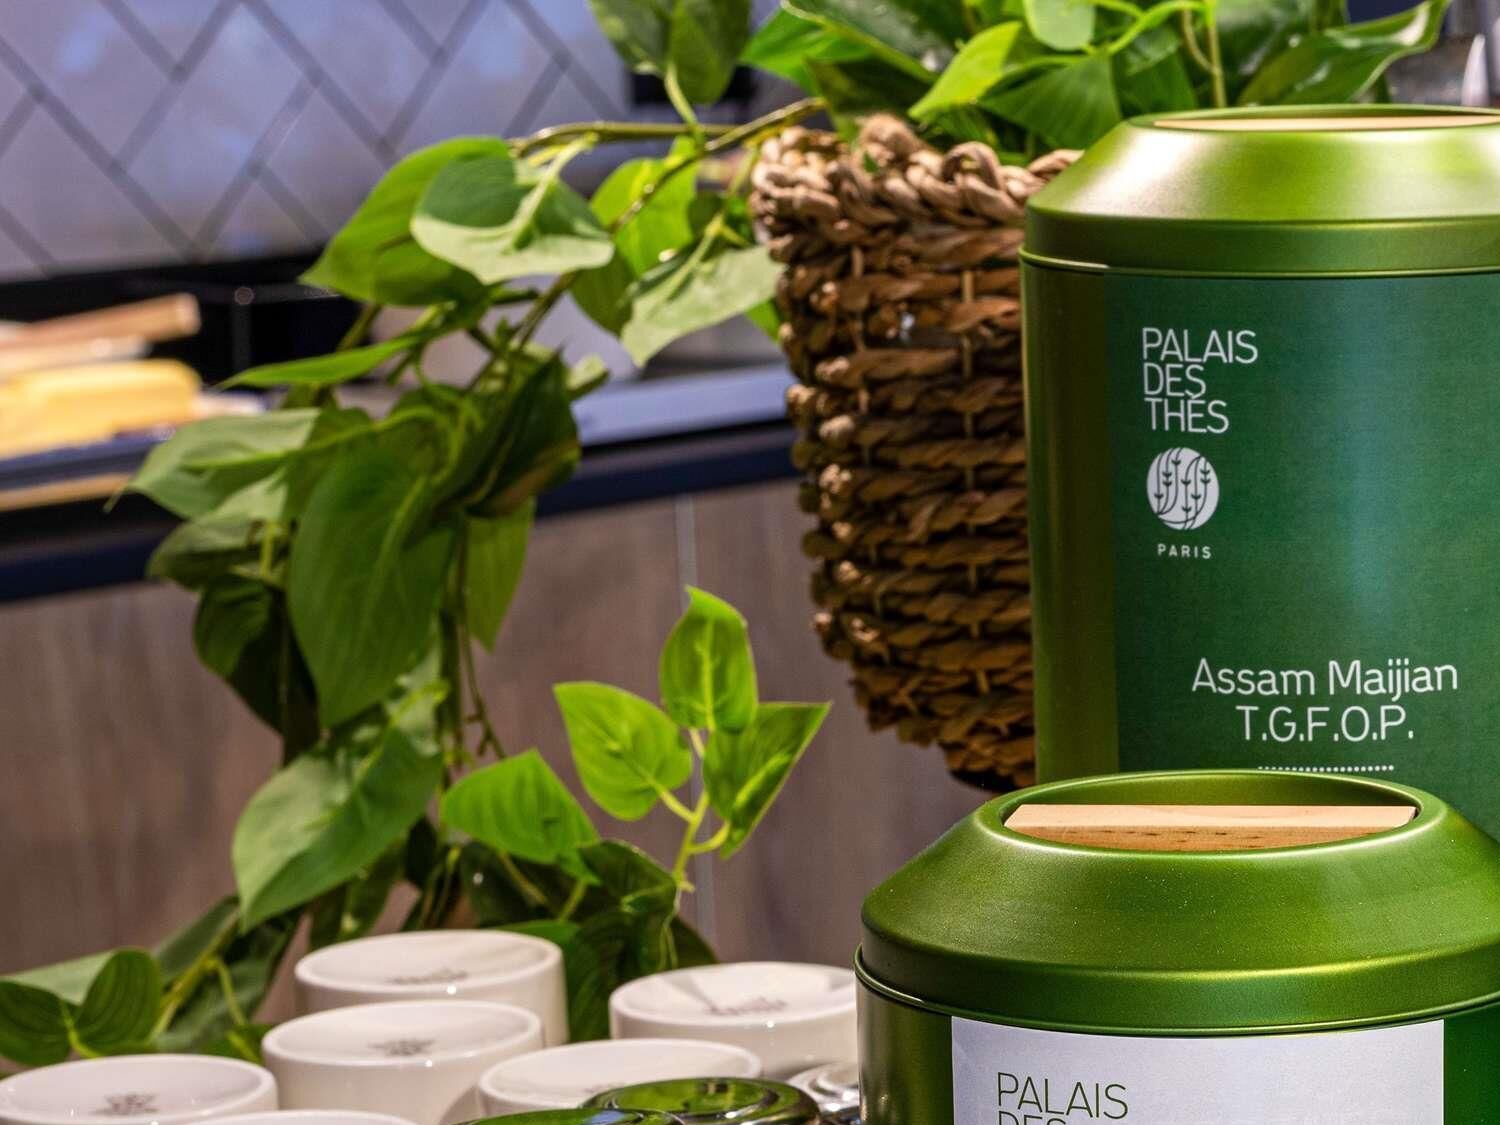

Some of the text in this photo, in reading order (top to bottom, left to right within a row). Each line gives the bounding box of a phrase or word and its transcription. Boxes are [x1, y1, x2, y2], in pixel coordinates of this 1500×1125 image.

[1142, 327, 1258, 365] PALAIS
[1143, 364, 1207, 399] DES
[1147, 393, 1229, 434] THÉS
[1158, 544, 1211, 559] PARIS
[1192, 658, 1457, 701] Assam Maijian
[998, 1072, 1128, 1120] PALAIS
